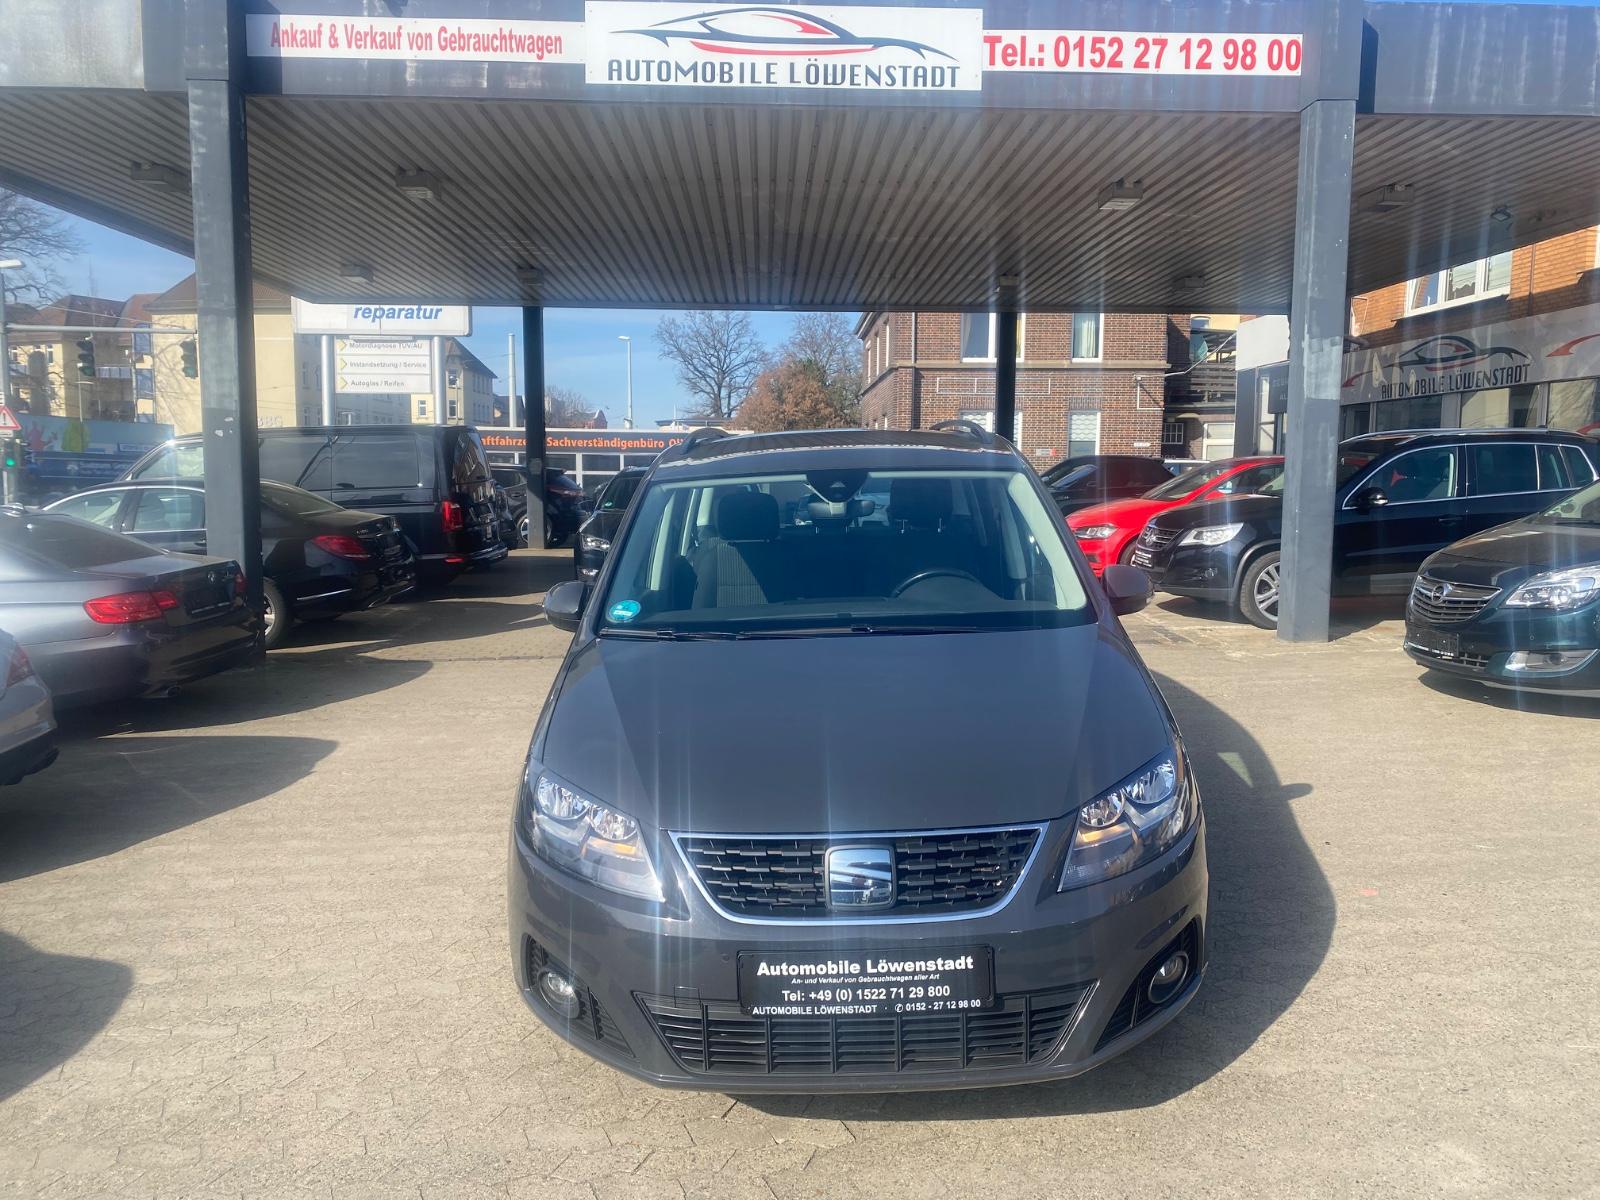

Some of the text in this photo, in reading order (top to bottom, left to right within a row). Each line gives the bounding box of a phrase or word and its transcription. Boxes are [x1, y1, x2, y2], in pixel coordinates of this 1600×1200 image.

[270, 22, 562, 61] Ankauf & Verkauf von Gebrauchtwagen
[983, 35, 1302, 71] Tel.: 0152 27 12 98 00
[607, 58, 961, 88] AUTOMOBILE LÖWENSTADT
[353, 304, 443, 323] reparatur
[1381, 363, 1531, 400] AUTOMOBILE LÖWENSTADT
[546, 436, 664, 449] Sachverständigenbüro
[756, 955, 974, 976] Automobile Löwenstadt
[818, 976, 843, 984] Verkauf
[858, 975, 913, 983] Gebrauchtwagen
[781, 985, 951, 1002] Tel: +49 (0) 1522 71 29 800
[752, 1006, 812, 1015] AUTOMOBILE
[814, 1004, 878, 1015] LÖWENSTADT
[905, 1002, 926, 1011] 0152
[933, 1001, 944, 1010] 27
[946, 1000, 957, 1009] 12
[958, 999, 969, 1008] 98
[970, 999, 981, 1008] 00
